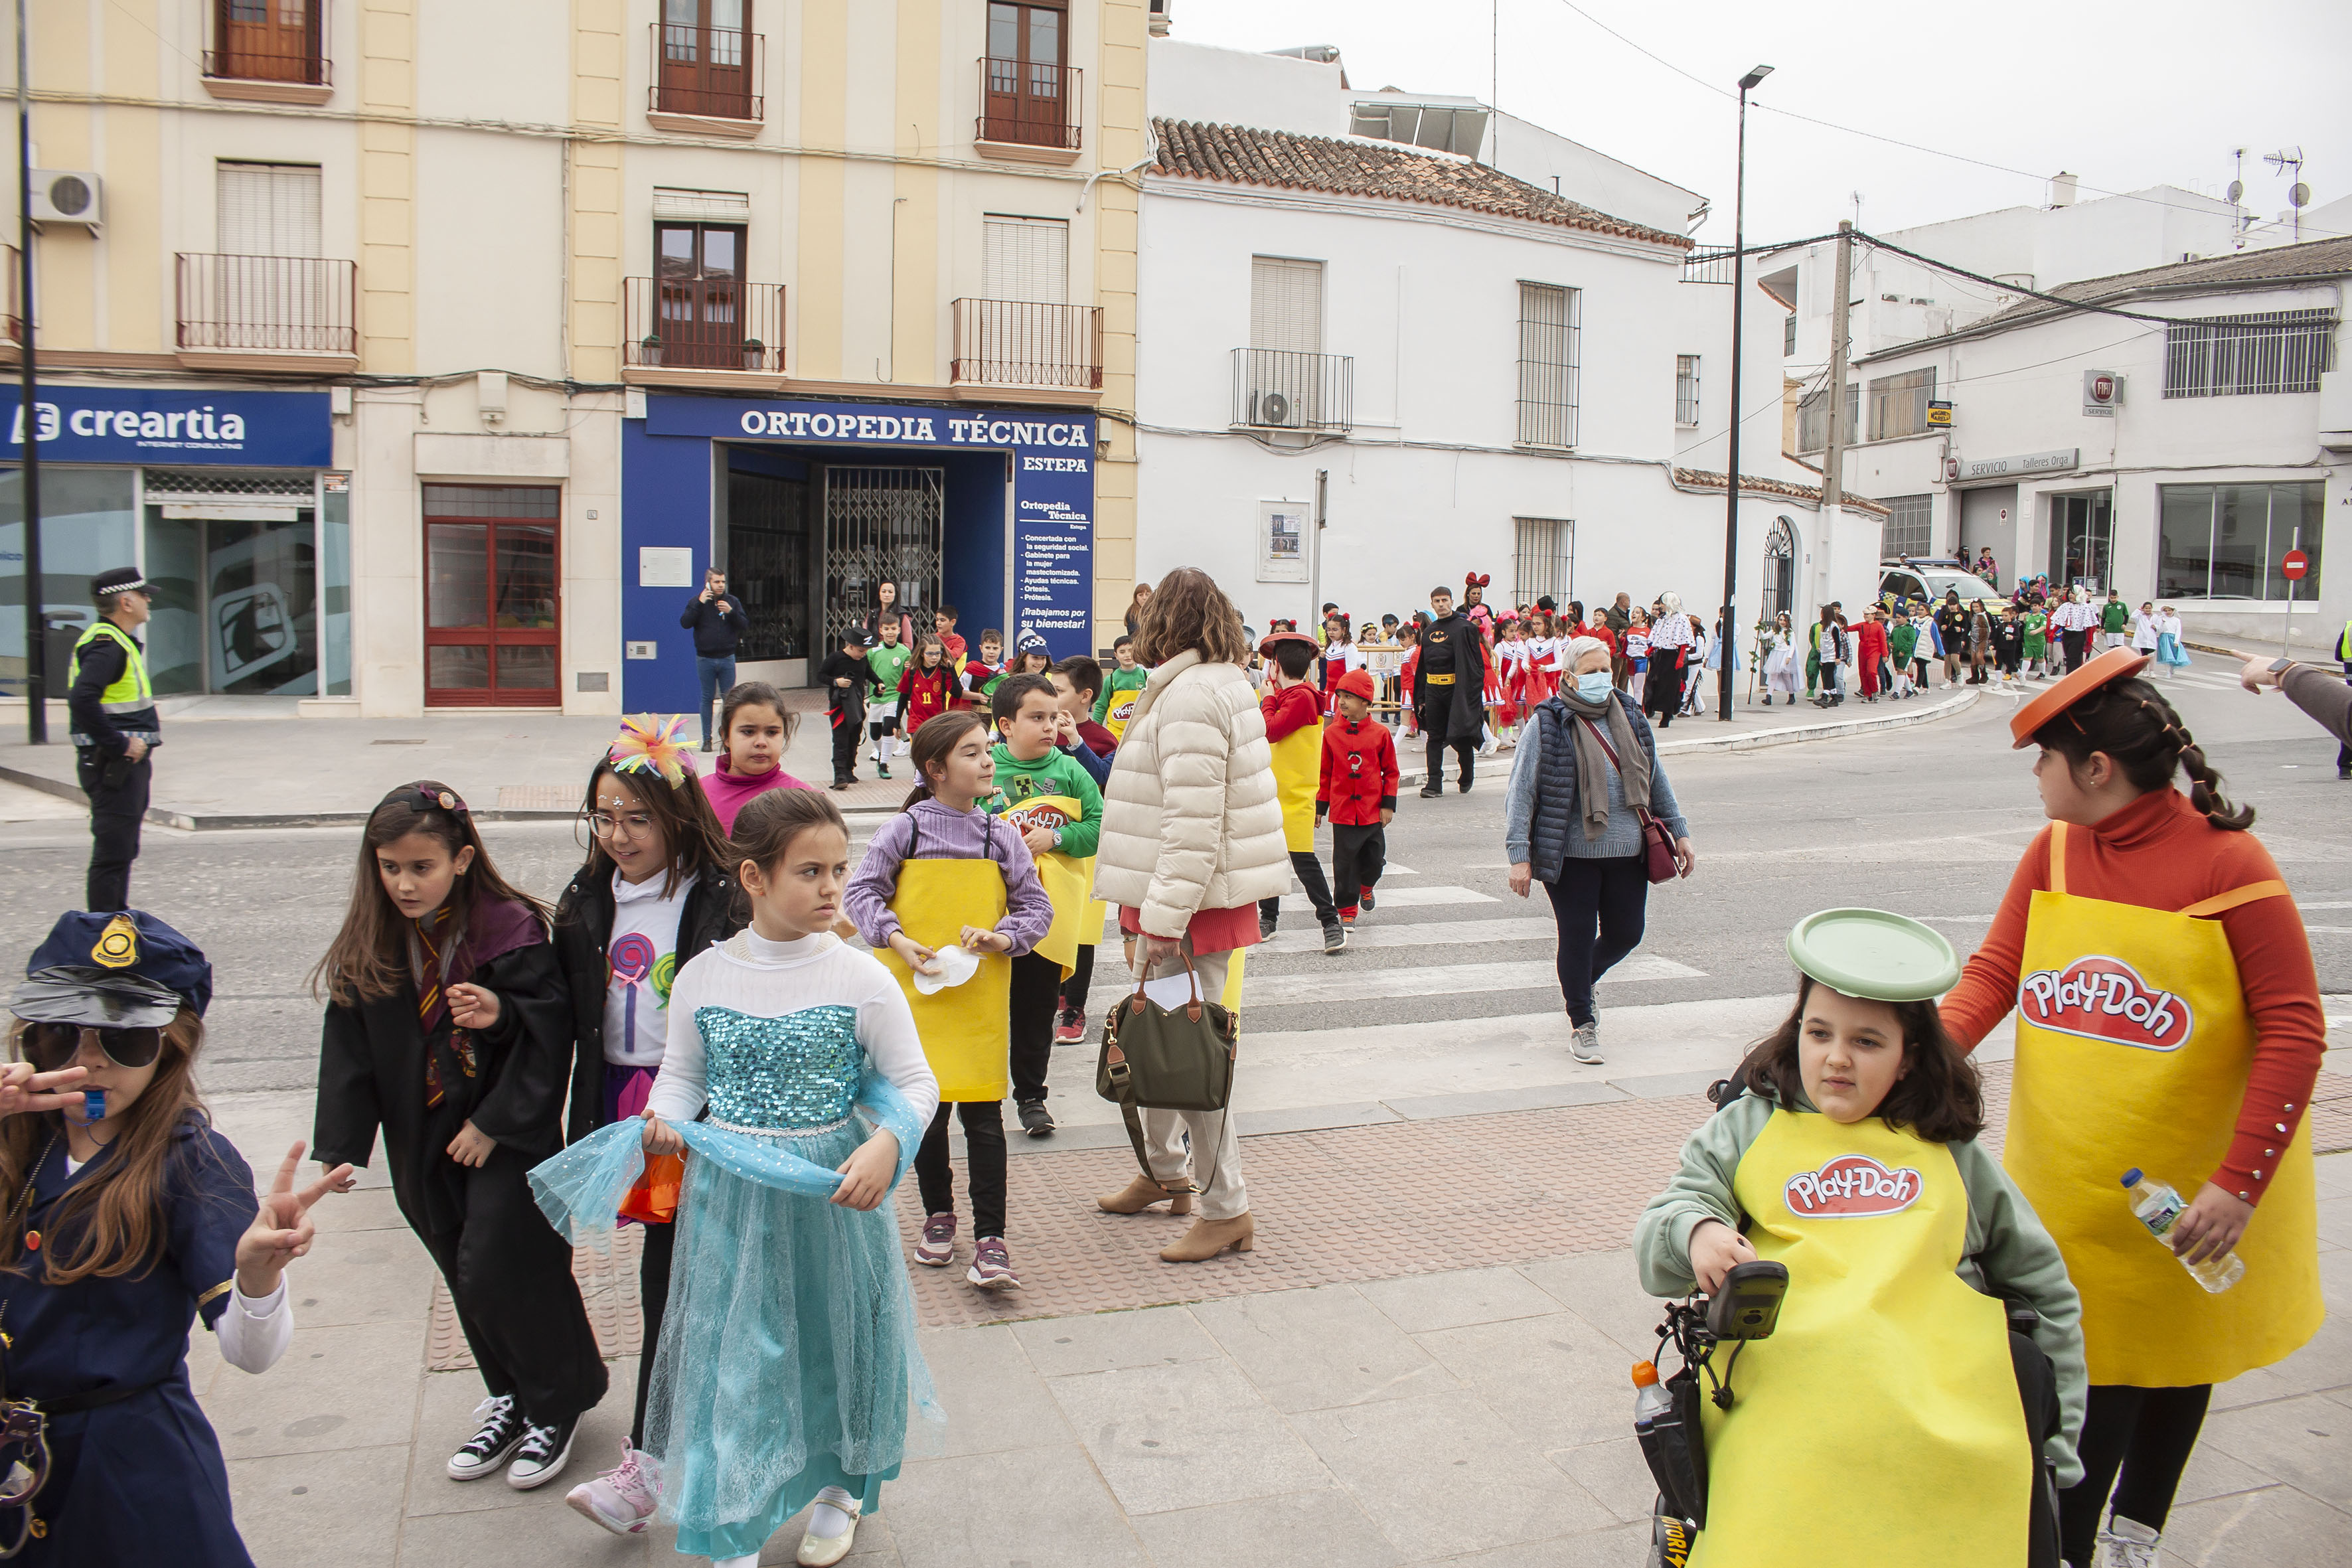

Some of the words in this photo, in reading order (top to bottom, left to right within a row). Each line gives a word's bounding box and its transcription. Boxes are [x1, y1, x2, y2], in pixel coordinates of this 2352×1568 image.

[2097, 382, 2112, 395] FIAT
[70, 405, 245, 440] creartia
[741, 410, 936, 441] ORTOPEDIA
[949, 414, 1089, 447] TÉCNICA
[1023, 457, 1088, 473] ESTEPA
[1971, 461, 2007, 475] SERVICIO
[2023, 457, 2049, 469] Talleres
[2051, 455, 2069, 467] Orga
[1020, 501, 1071, 512] Ortopedia
[1048, 510, 1087, 520] Técnica
[1021, 607, 1069, 617] ¡Trabajamos
[1070, 609, 1086, 618] por
[1035, 619, 1086, 629] bienestar!
[863, 635, 872, 645] Z
[922, 692, 932, 704] 11
[1009, 809, 1064, 835] Play-D
[2025, 970, 2175, 1038] Play-Doh
[1788, 1166, 1911, 1210] Play-Doh
